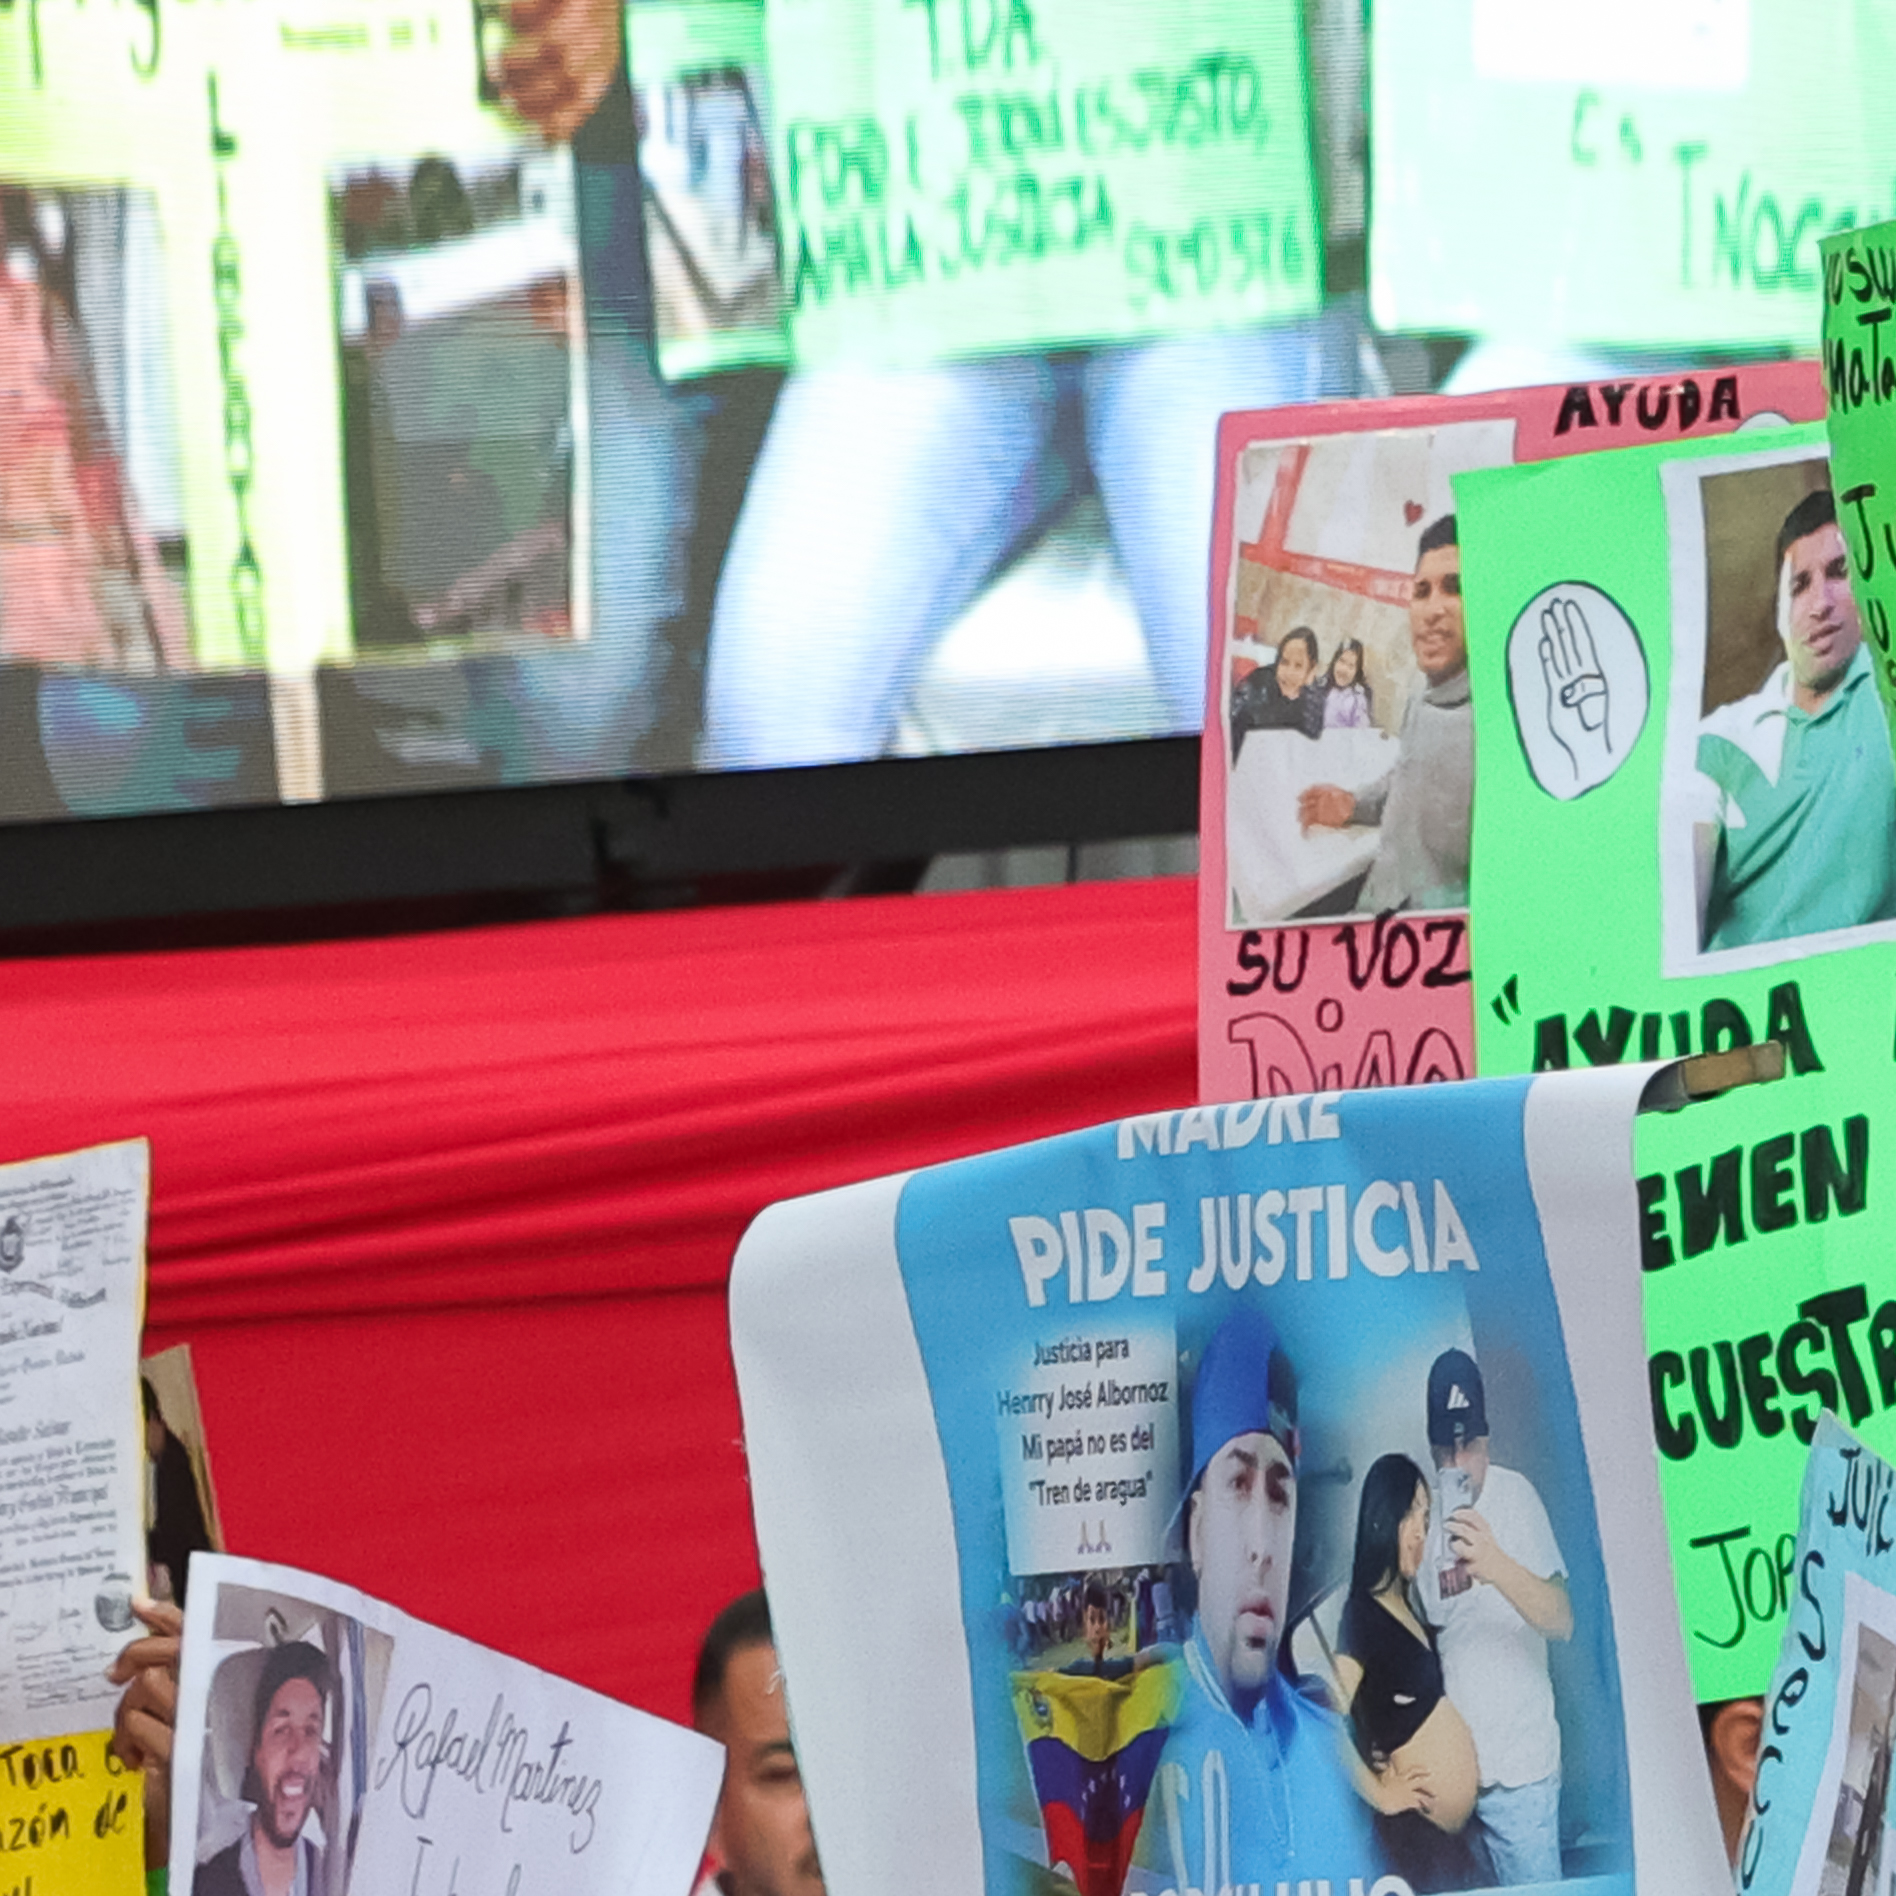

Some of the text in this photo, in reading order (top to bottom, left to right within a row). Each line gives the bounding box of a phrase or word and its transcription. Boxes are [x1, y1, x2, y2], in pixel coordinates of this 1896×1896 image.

[1554, 374, 1743, 438] AYUDA
[1227, 907, 1472, 997] SU VOZ
[1008, 1178, 1481, 1308] PIDE JUSTICIA
[1033, 1336, 1130, 1368] Justicia para
[1058, 1381, 1092, 1411] José
[1096, 1379, 1169, 1408] Albornoz
[1022, 1422, 1154, 1466] Mi papá no es del
[1073, 1477, 1091, 1503] de
